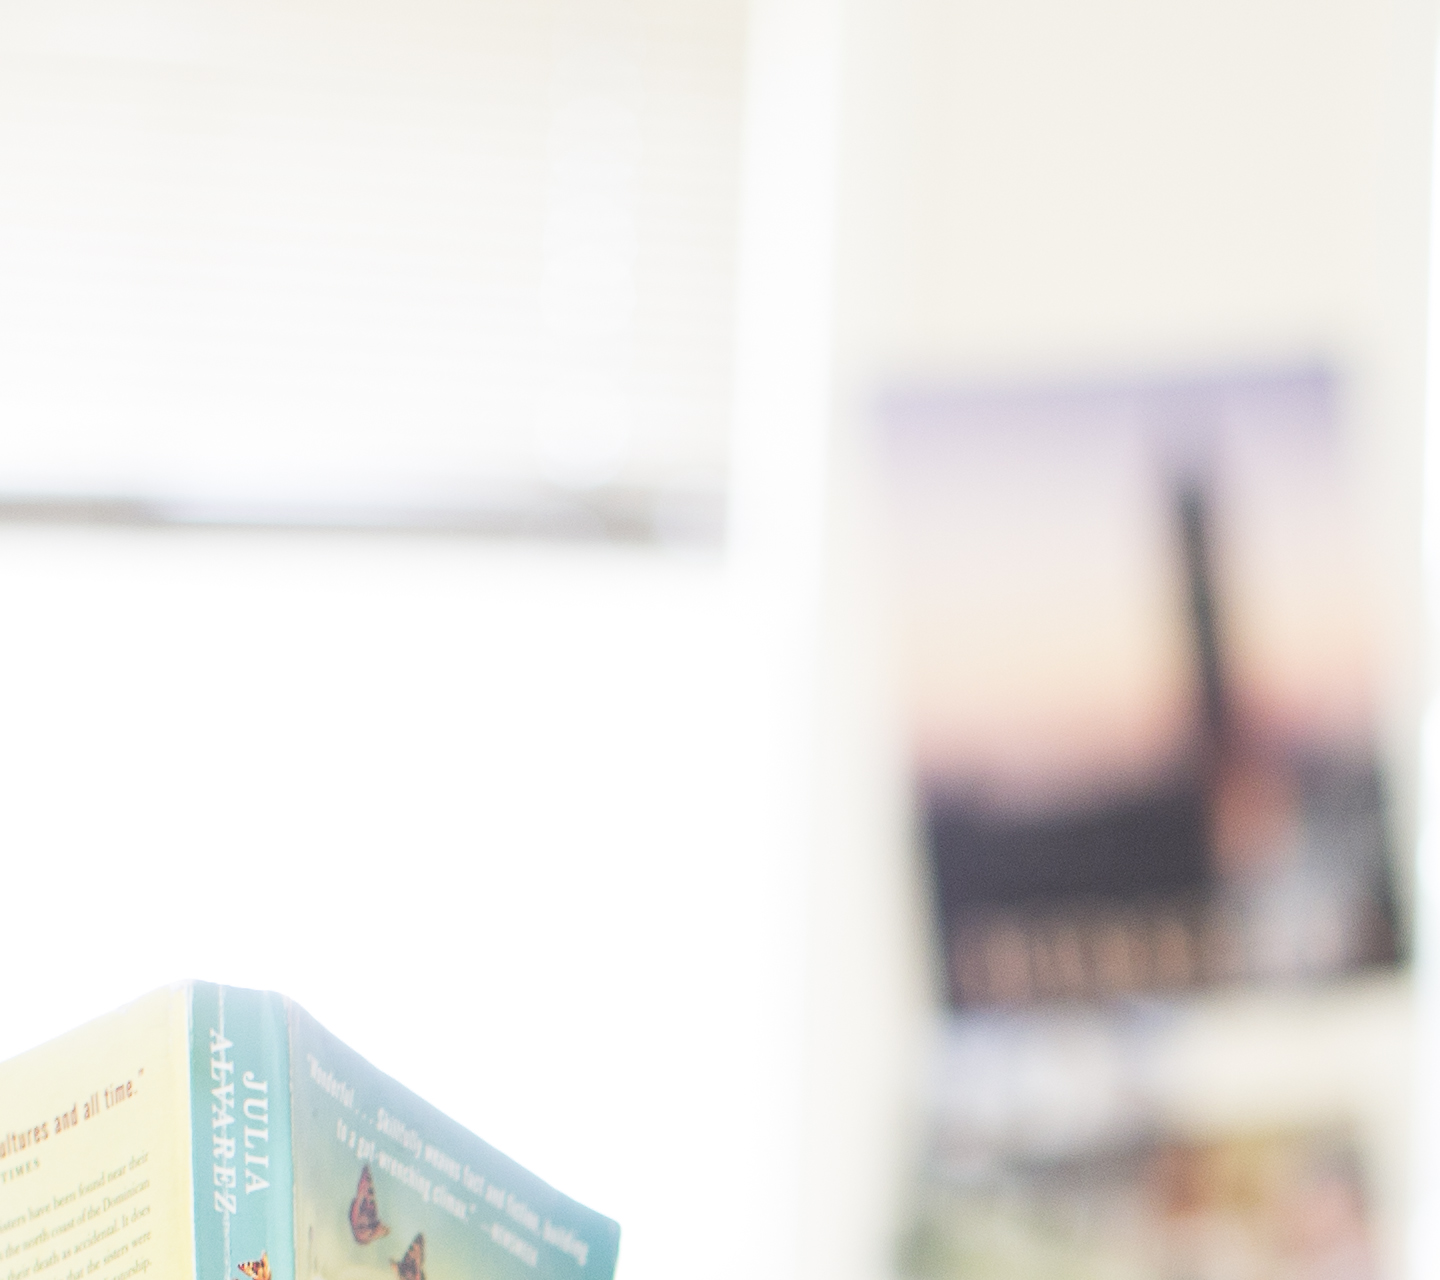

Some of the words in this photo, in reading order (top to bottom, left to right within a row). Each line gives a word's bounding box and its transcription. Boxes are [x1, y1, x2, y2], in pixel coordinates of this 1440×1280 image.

[53, 1104, 78, 1134] and
[83, 1092, 99, 1120] all
[103, 1068, 144, 1109] time."
[210, 1028, 237, 1214] ALVAREZ
[243, 1070, 270, 1194] JULIA
[1, 1158, 40, 1184] TIMES
[79, 1171, 104, 1198] found
[108, 1165, 126, 1183] near
[129, 1151, 148, 1171] their
[88, 1205, 100, 1220] the
[102, 1180, 149, 1212] Dominican
[130, 1205, 149, 1223] does
[132, 1231, 150, 1248] were
